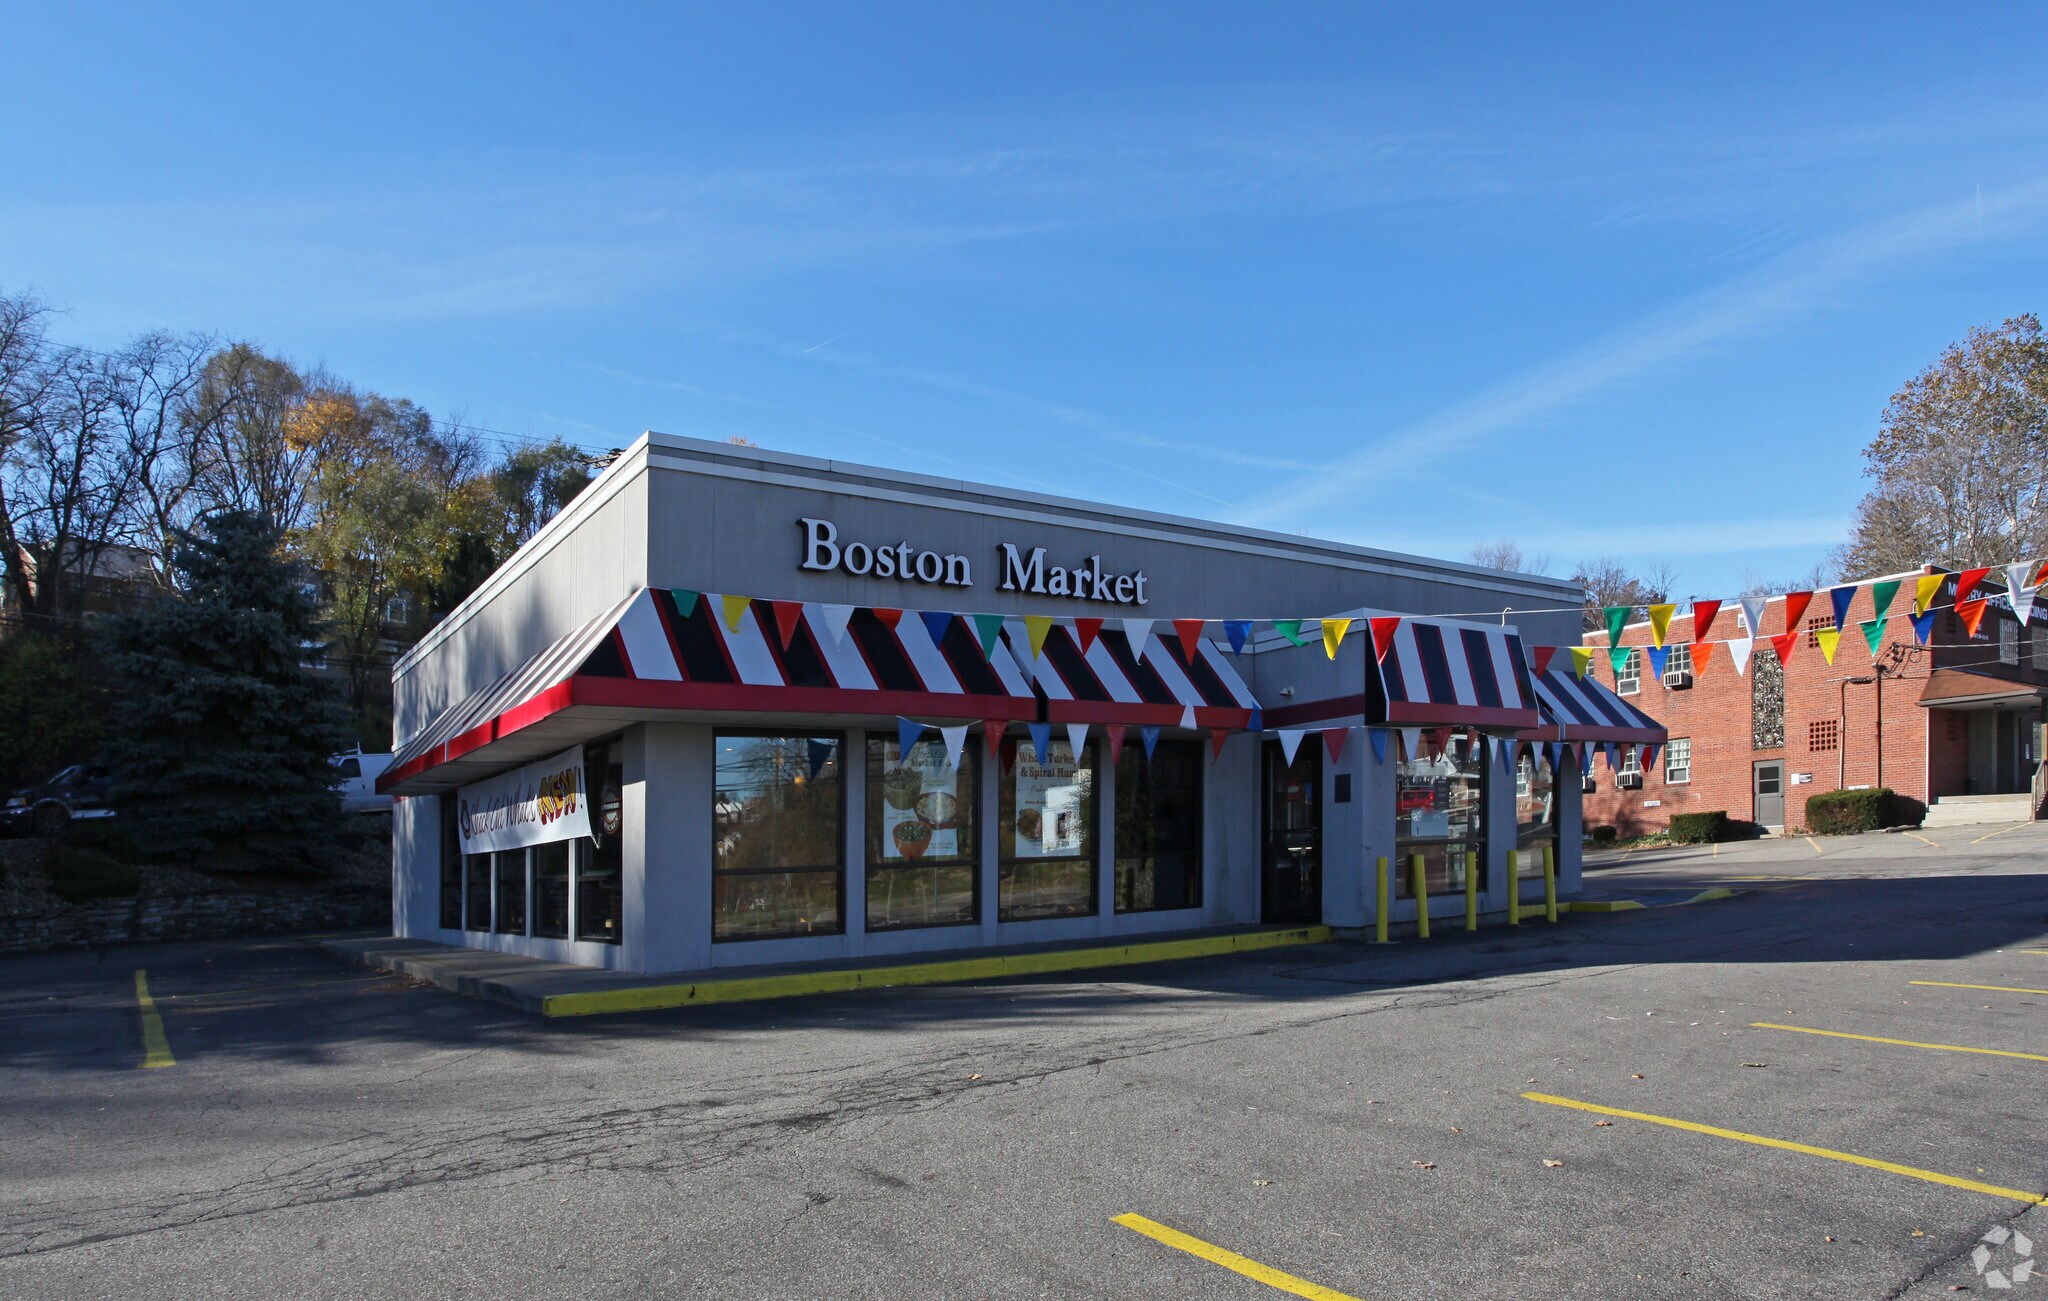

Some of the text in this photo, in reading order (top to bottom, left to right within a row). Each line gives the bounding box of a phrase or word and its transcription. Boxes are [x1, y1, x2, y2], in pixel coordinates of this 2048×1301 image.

[799, 516, 1150, 606] Boston Market
[538, 767, 583, 825] NEW!
[1020, 767, 1028, 777] &
[1029, 767, 1055, 780] Spiral
